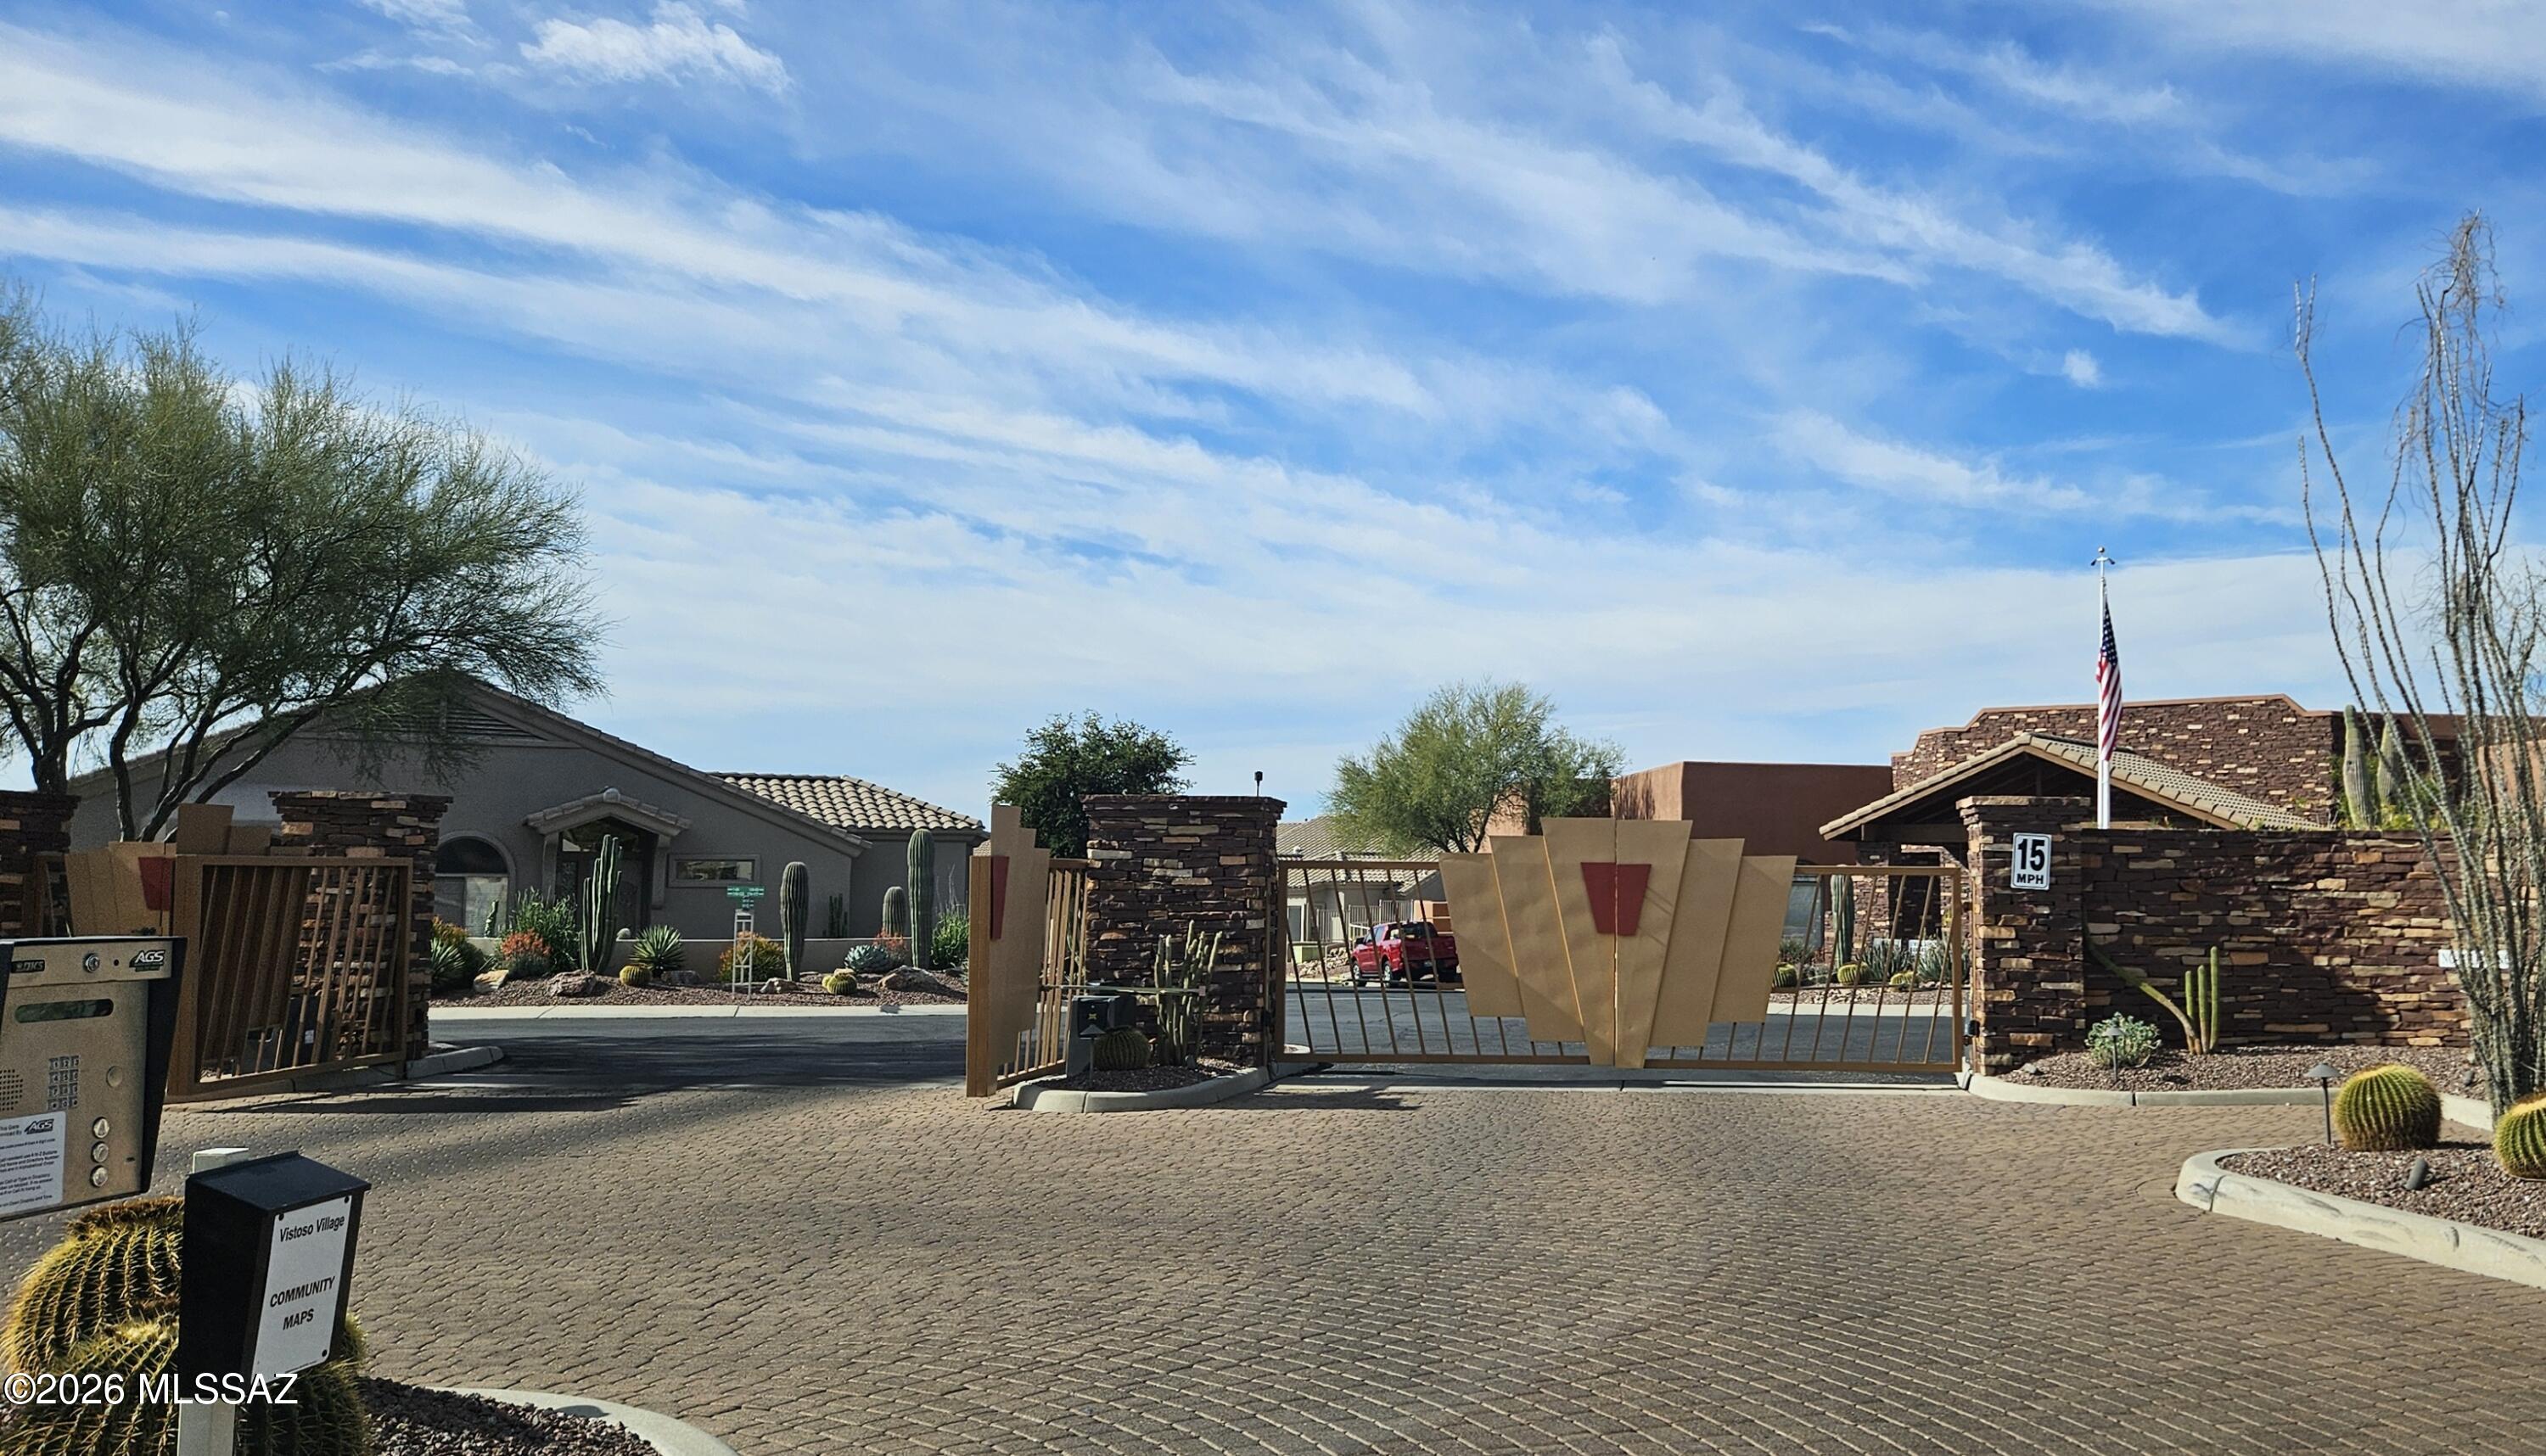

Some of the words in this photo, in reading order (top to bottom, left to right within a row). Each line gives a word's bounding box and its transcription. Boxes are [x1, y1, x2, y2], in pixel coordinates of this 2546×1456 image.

[2018, 838, 2044, 871] 15
[2016, 873, 2044, 884] MPH
[135, 950, 164, 963] AGS
[29, 1121, 52, 1131] AGS
[280, 1224, 314, 1242] Vistoso
[317, 1216, 345, 1232] Village
[270, 1276, 335, 1307] COMMUNITY
[283, 1308, 314, 1330] MAPS
